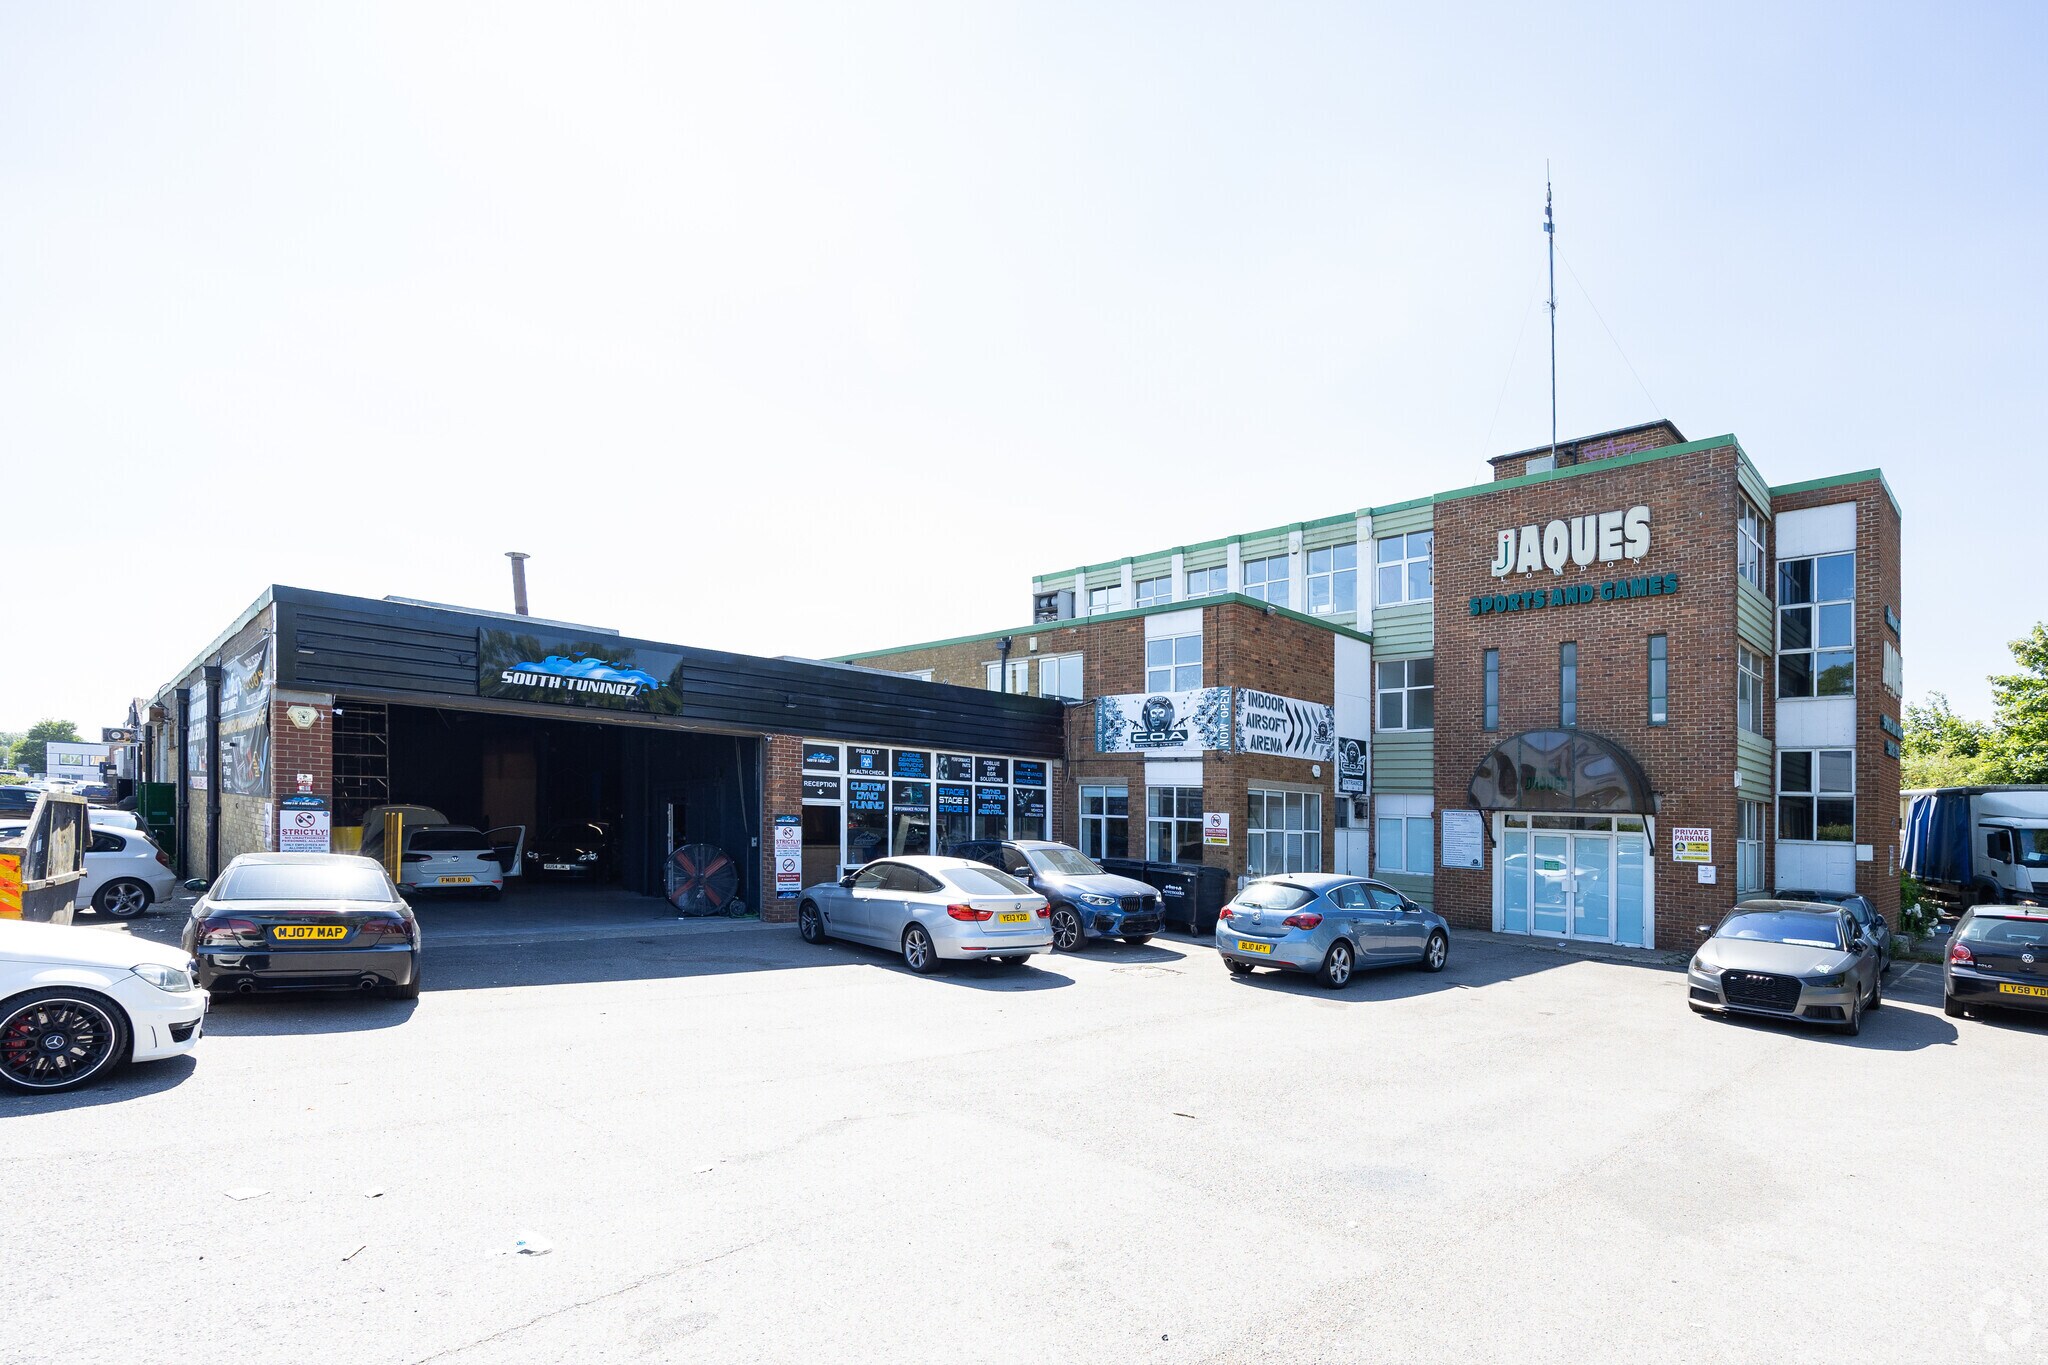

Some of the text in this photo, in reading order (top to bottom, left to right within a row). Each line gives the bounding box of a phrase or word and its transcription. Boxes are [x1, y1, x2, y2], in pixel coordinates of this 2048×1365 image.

[1491, 504, 1652, 577] JAQUES
[1469, 572, 1679, 616] SPORTS AND GAMES
[501, 670, 638, 697] SOUTH TUNINGZ
[1248, 691, 1285, 713] INDOOR
[1219, 689, 1230, 748] NOW OPEN
[1246, 712, 1288, 733] AIRSOFT
[1250, 734, 1283, 753] ARENA
[803, 780, 838, 788] RECEPTION
[850, 781, 886, 792] CUSTOM
[856, 791, 879, 801] DYNO
[939, 787, 964, 796] STAGE
[849, 800, 885, 810] TUNING
[938, 796, 969, 805] STAGE 2
[938, 804, 969, 813] STAGE 3
[282, 828, 328, 836] STRICTLY!
[1002, 914, 1015, 922] YE13
[278, 927, 343, 937] MJ07 MAP
[2003, 984, 2031, 995] LV58
